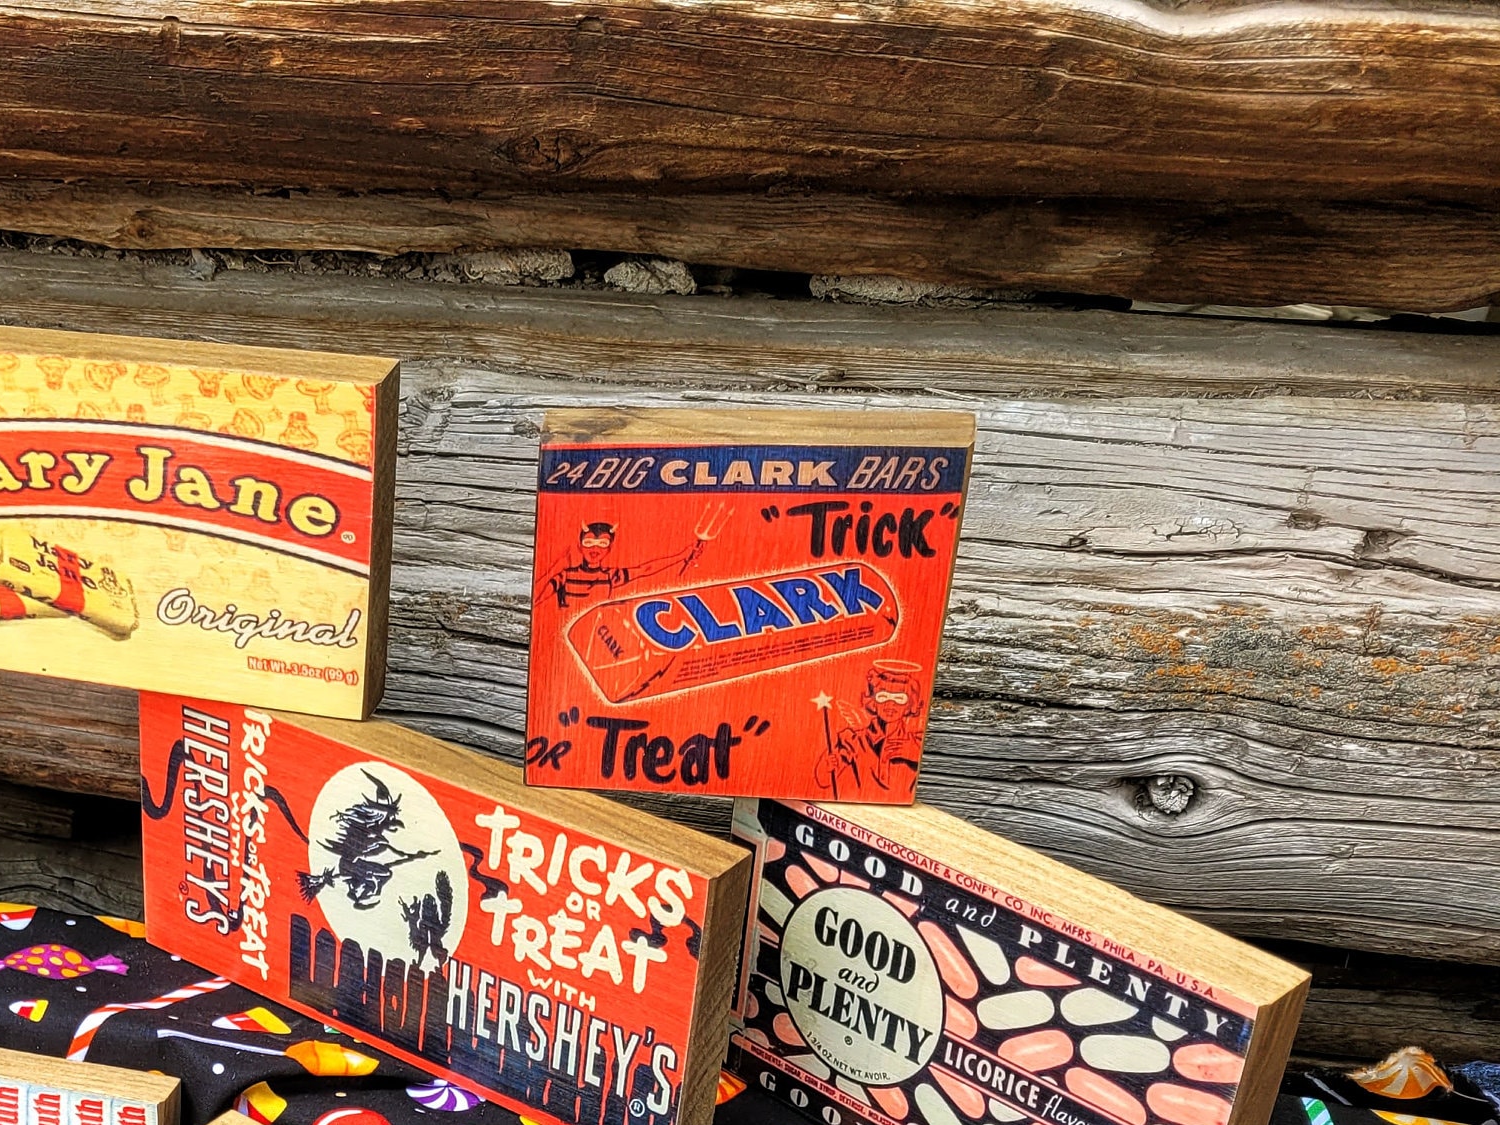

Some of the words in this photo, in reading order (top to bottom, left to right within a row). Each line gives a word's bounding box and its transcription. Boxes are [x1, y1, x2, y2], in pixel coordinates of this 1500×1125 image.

[127, 444, 341, 539] Jane
[546, 463, 584, 486] 24
[584, 456, 653, 490] BIG
[659, 459, 838, 488] CLARK
[846, 455, 949, 490] BARS
[30, 536, 94, 571] Mary
[156, 587, 361, 649] Original
[597, 624, 625, 659] CLARK
[634, 567, 886, 651] CLARK
[241, 708, 274, 844] TRICKS
[181, 704, 238, 936] HERSHEY'S
[230, 791, 241, 868] WITH
[247, 838, 259, 867] OR
[805, 805, 848, 832] QUAKER
[850, 826, 874, 843] CITY
[876, 836, 940, 875] CHOCOLATE
[943, 869, 951, 879] &
[1004, 895, 1025, 913] CO.
[476, 805, 693, 928] TRICKS
[566, 890, 602, 922] OR
[240, 861, 272, 981] TREAT
[479, 890, 669, 995] TREAT
[795, 823, 924, 897] GOOD
[945, 898, 997, 928] and
[1017, 923, 1229, 1038] PLENTY
[814, 906, 917, 984] GOOD
[527, 968, 596, 1012] WITH
[786, 960, 933, 1066] PLENTY
[838, 967, 880, 994] and
[445, 957, 677, 1117] HERSHEY'S
[943, 1042, 1041, 1110] LICORICE
